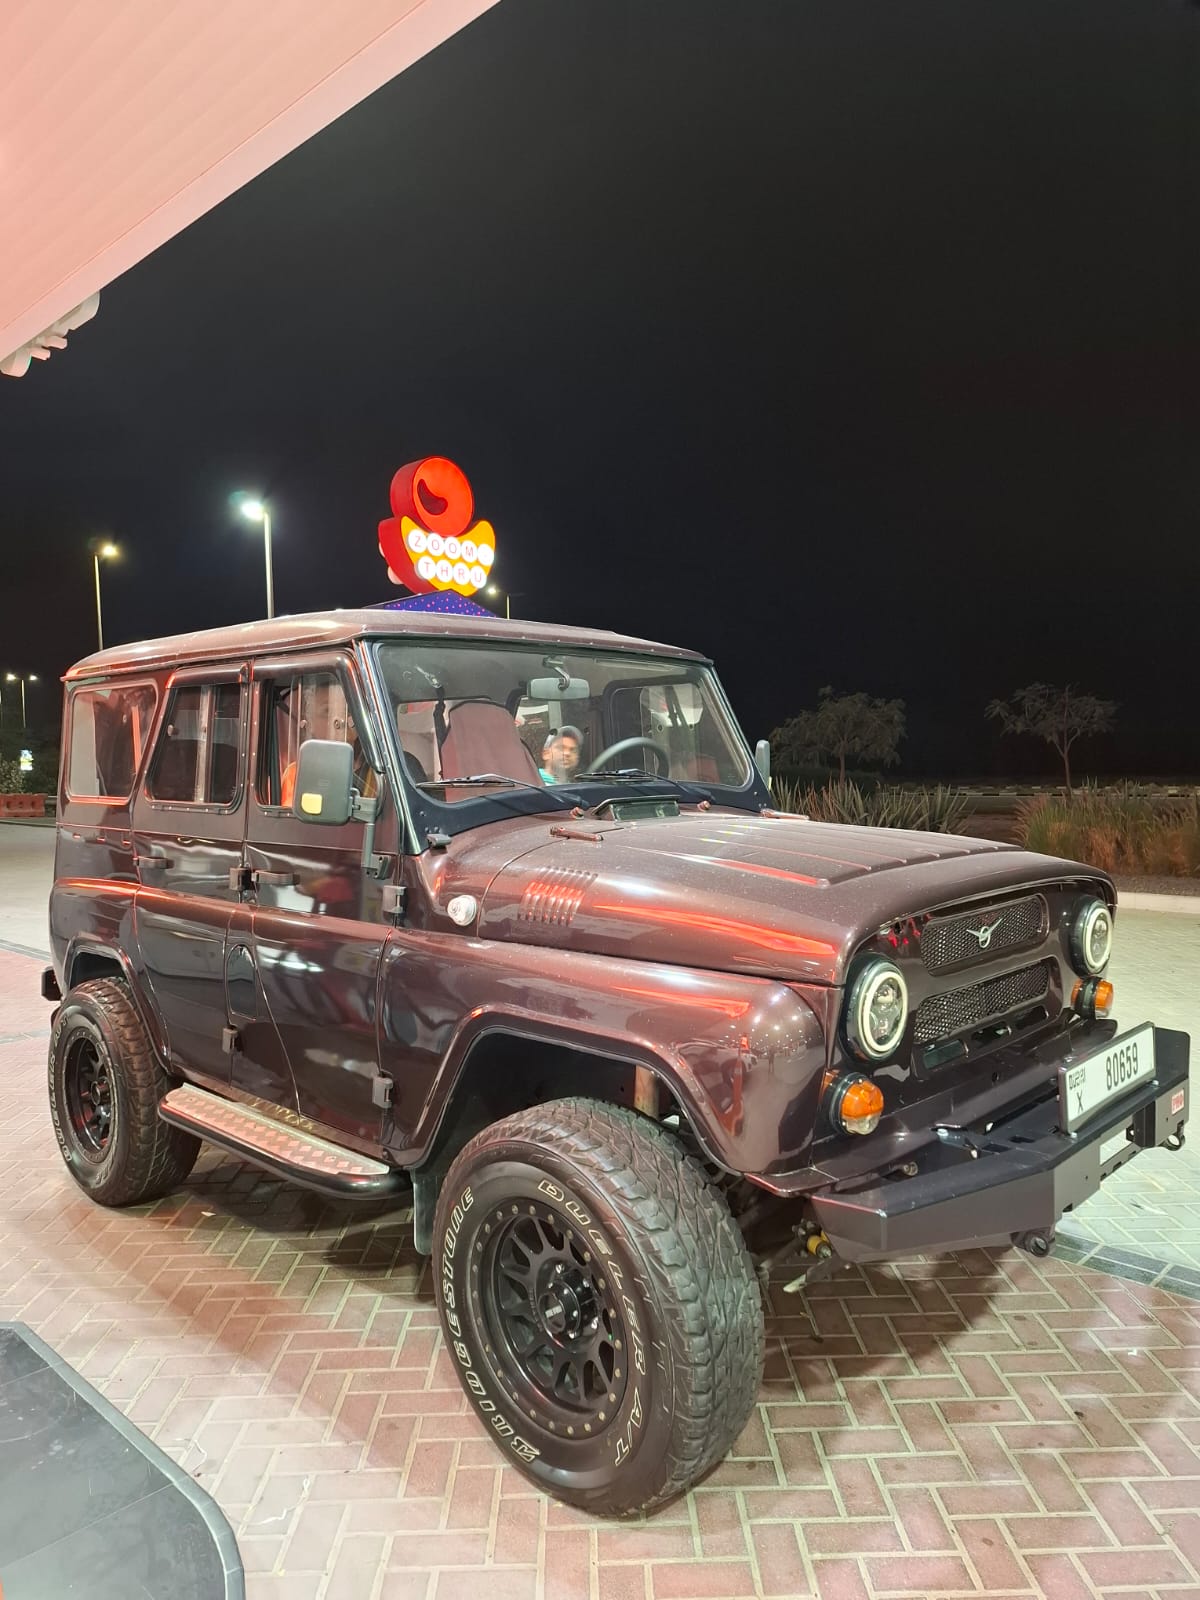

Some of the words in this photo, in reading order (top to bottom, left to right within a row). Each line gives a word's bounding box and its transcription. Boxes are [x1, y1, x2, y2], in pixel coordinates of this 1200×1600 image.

[414, 535, 474, 558] ZOOM
[423, 561, 482, 583] THRU
[1105, 1041, 1139, 1091] 80659
[1076, 1090, 1084, 1114] X
[441, 1186, 542, 1464] BRIDGESTONE
[537, 1178, 647, 1376] DUELER
[614, 1386, 643, 1467] A/T
